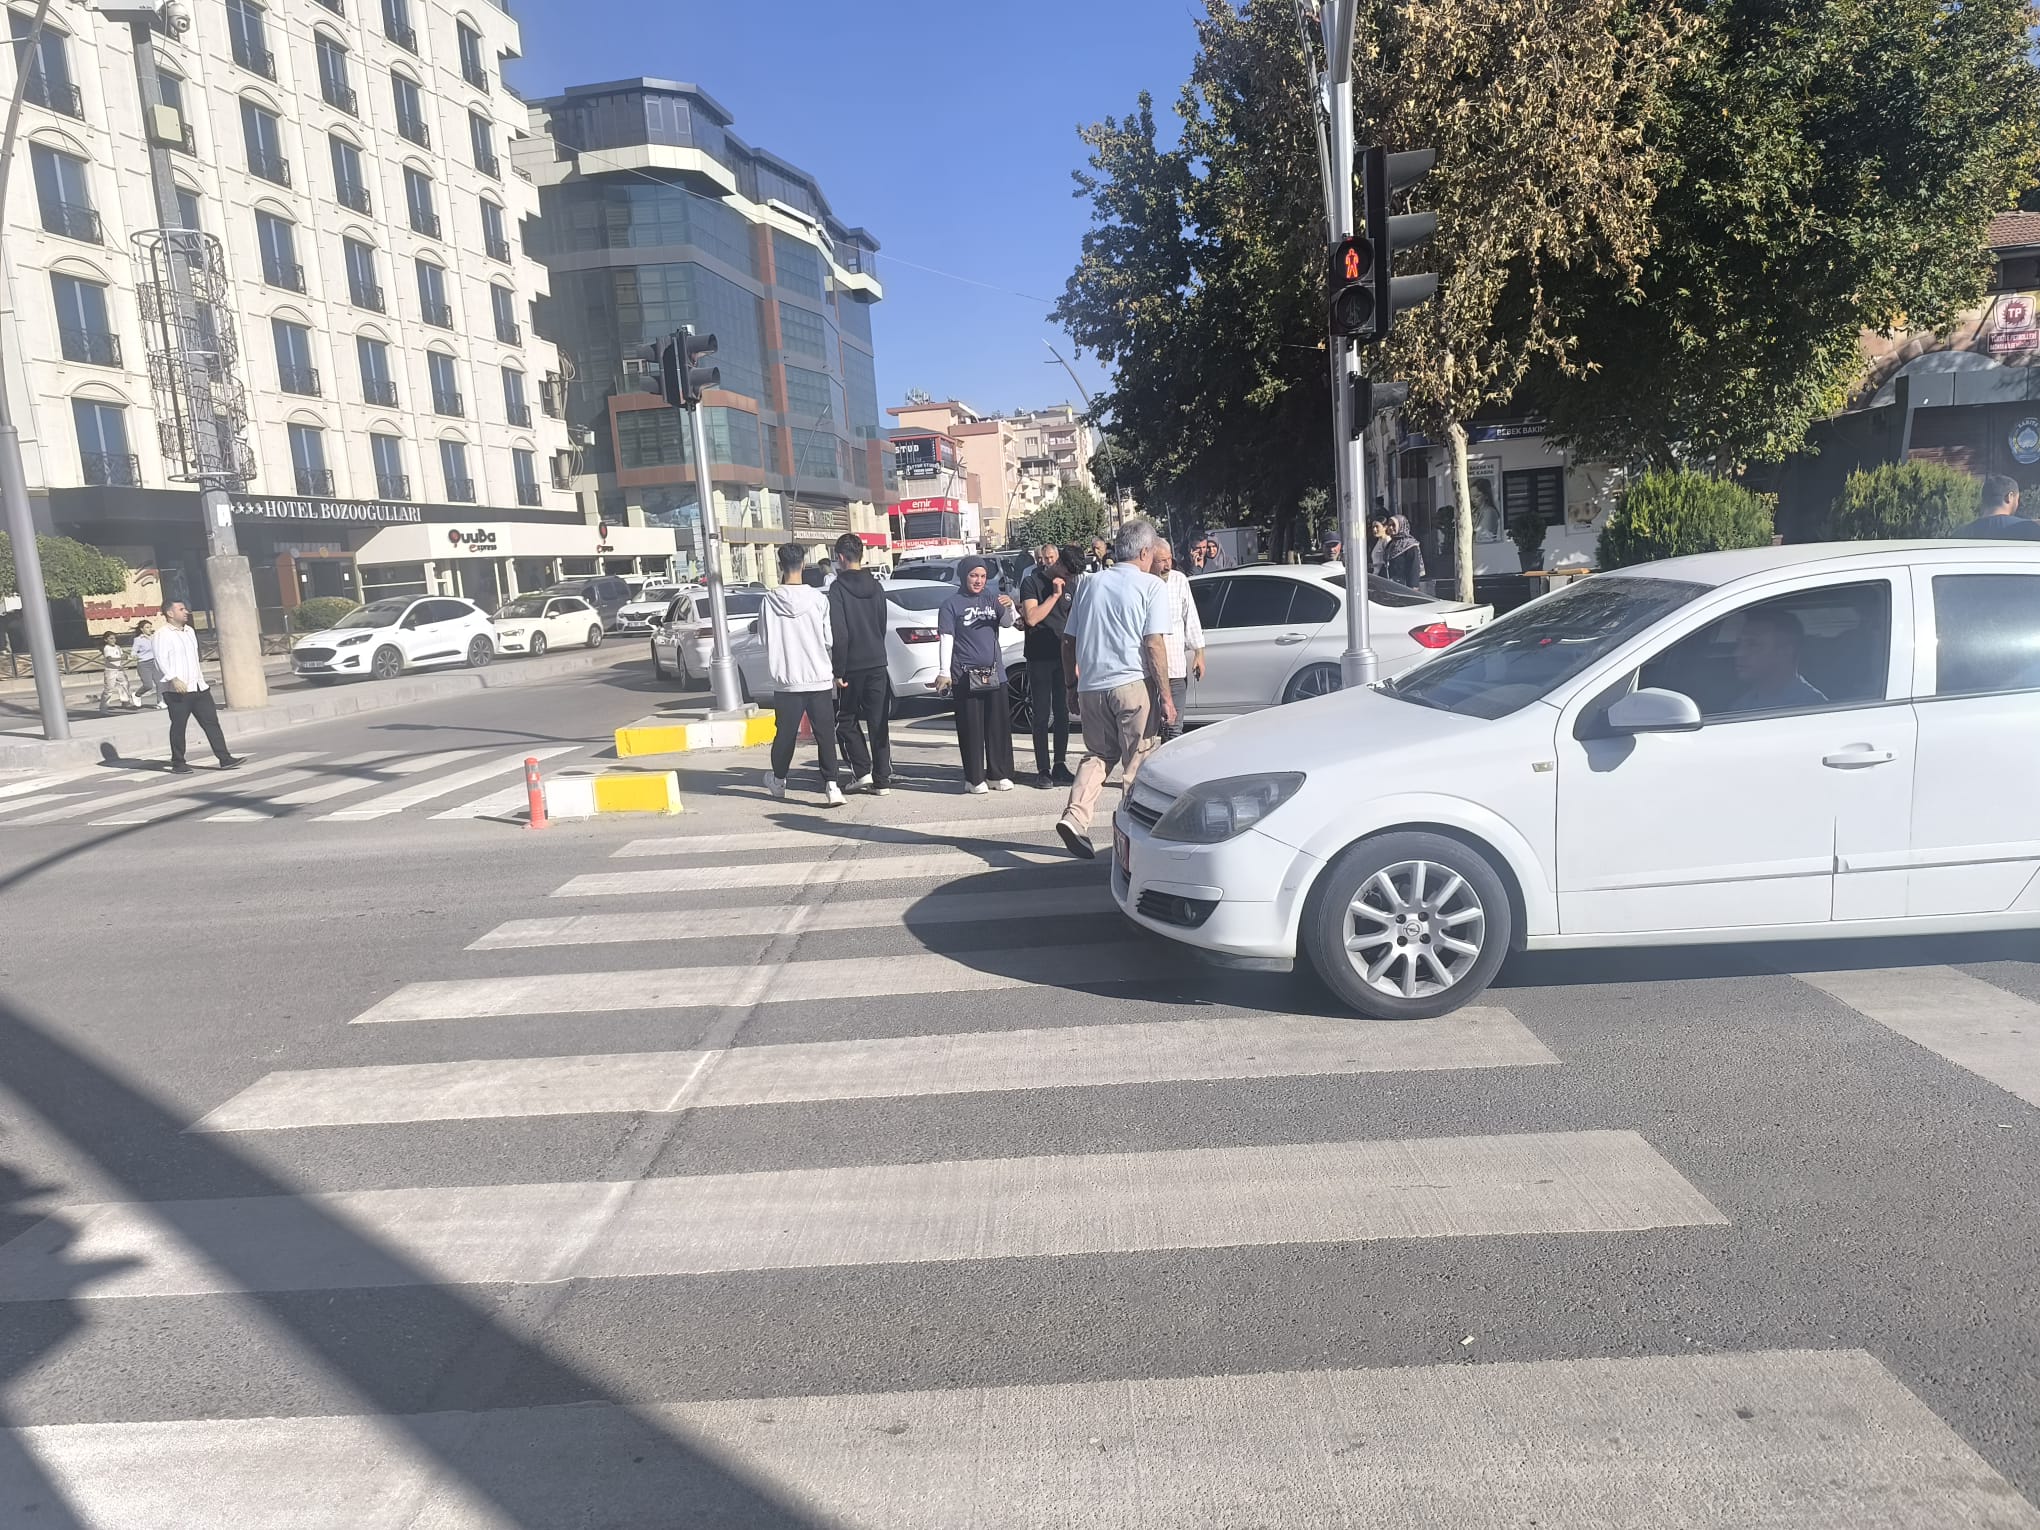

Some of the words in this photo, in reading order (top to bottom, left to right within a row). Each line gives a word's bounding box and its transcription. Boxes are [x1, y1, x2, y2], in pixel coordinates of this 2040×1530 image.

[2007, 307, 2022, 318] TP
[1496, 426, 1521, 437] BEBEK
[912, 499, 932, 508] emir
[264, 500, 318, 520] HOTEL
[319, 502, 422, 522] BOZOOĞULLARI
